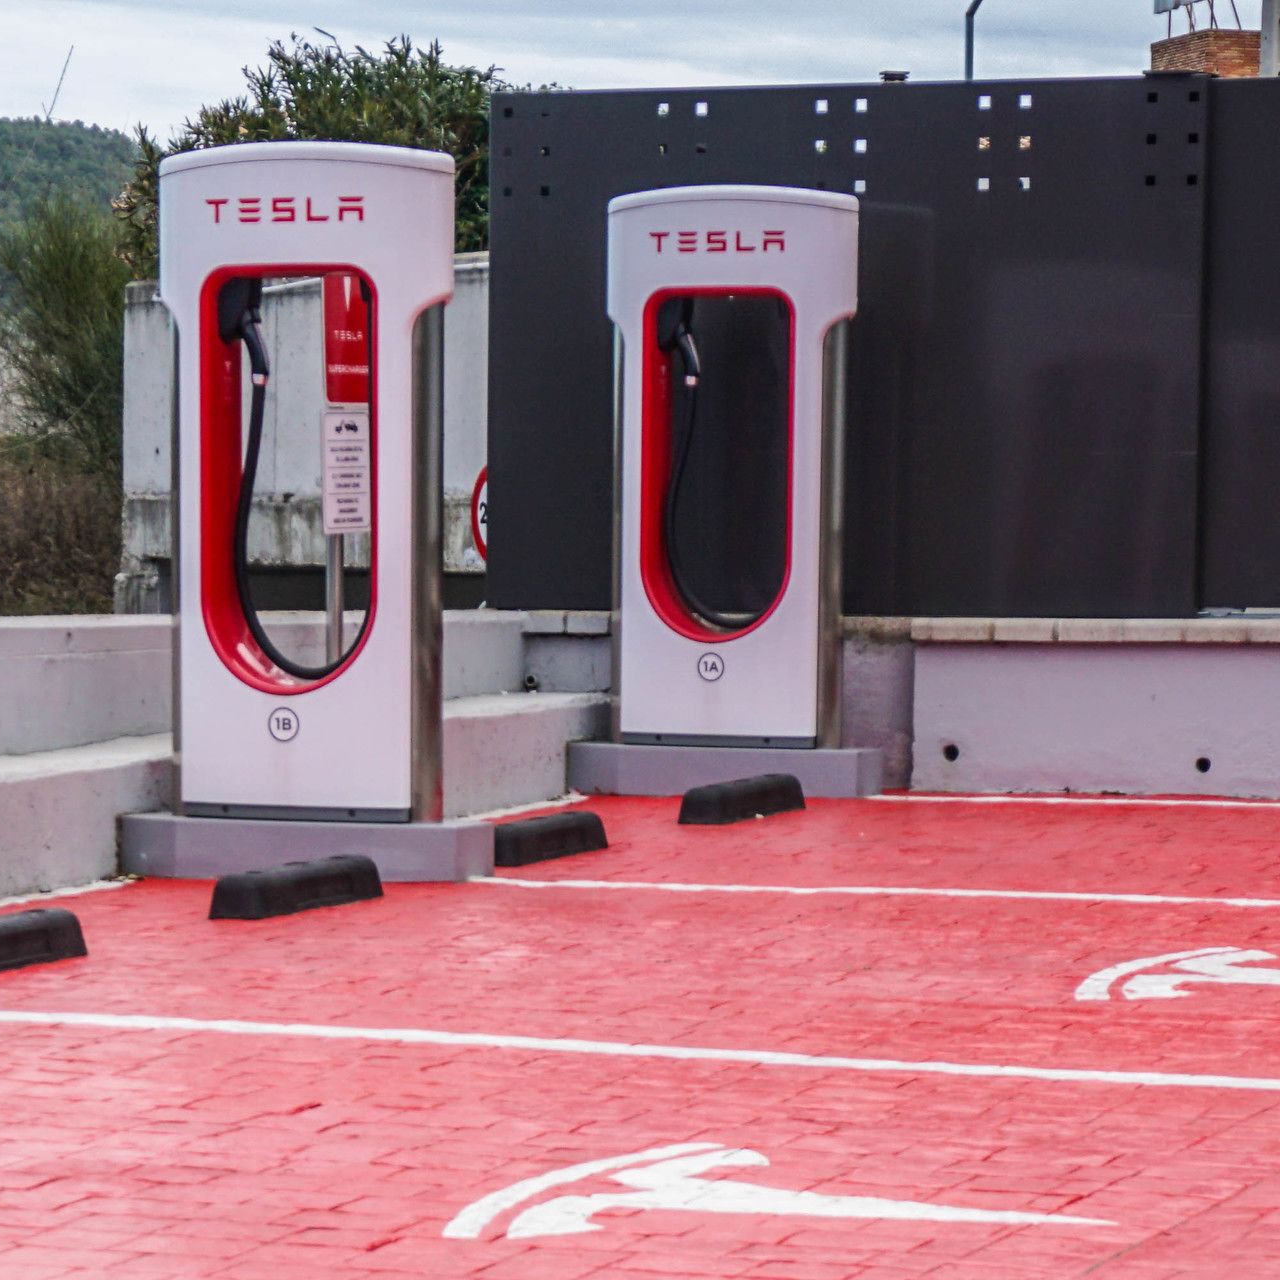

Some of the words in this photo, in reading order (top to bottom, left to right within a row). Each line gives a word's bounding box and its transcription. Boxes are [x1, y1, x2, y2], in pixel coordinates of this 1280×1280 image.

[205, 196, 364, 223] TESLA
[649, 230, 785, 253] TESLA
[334, 329, 363, 341] TESLA
[703, 660, 719, 672] 1A
[274, 717, 292, 731] 1B
